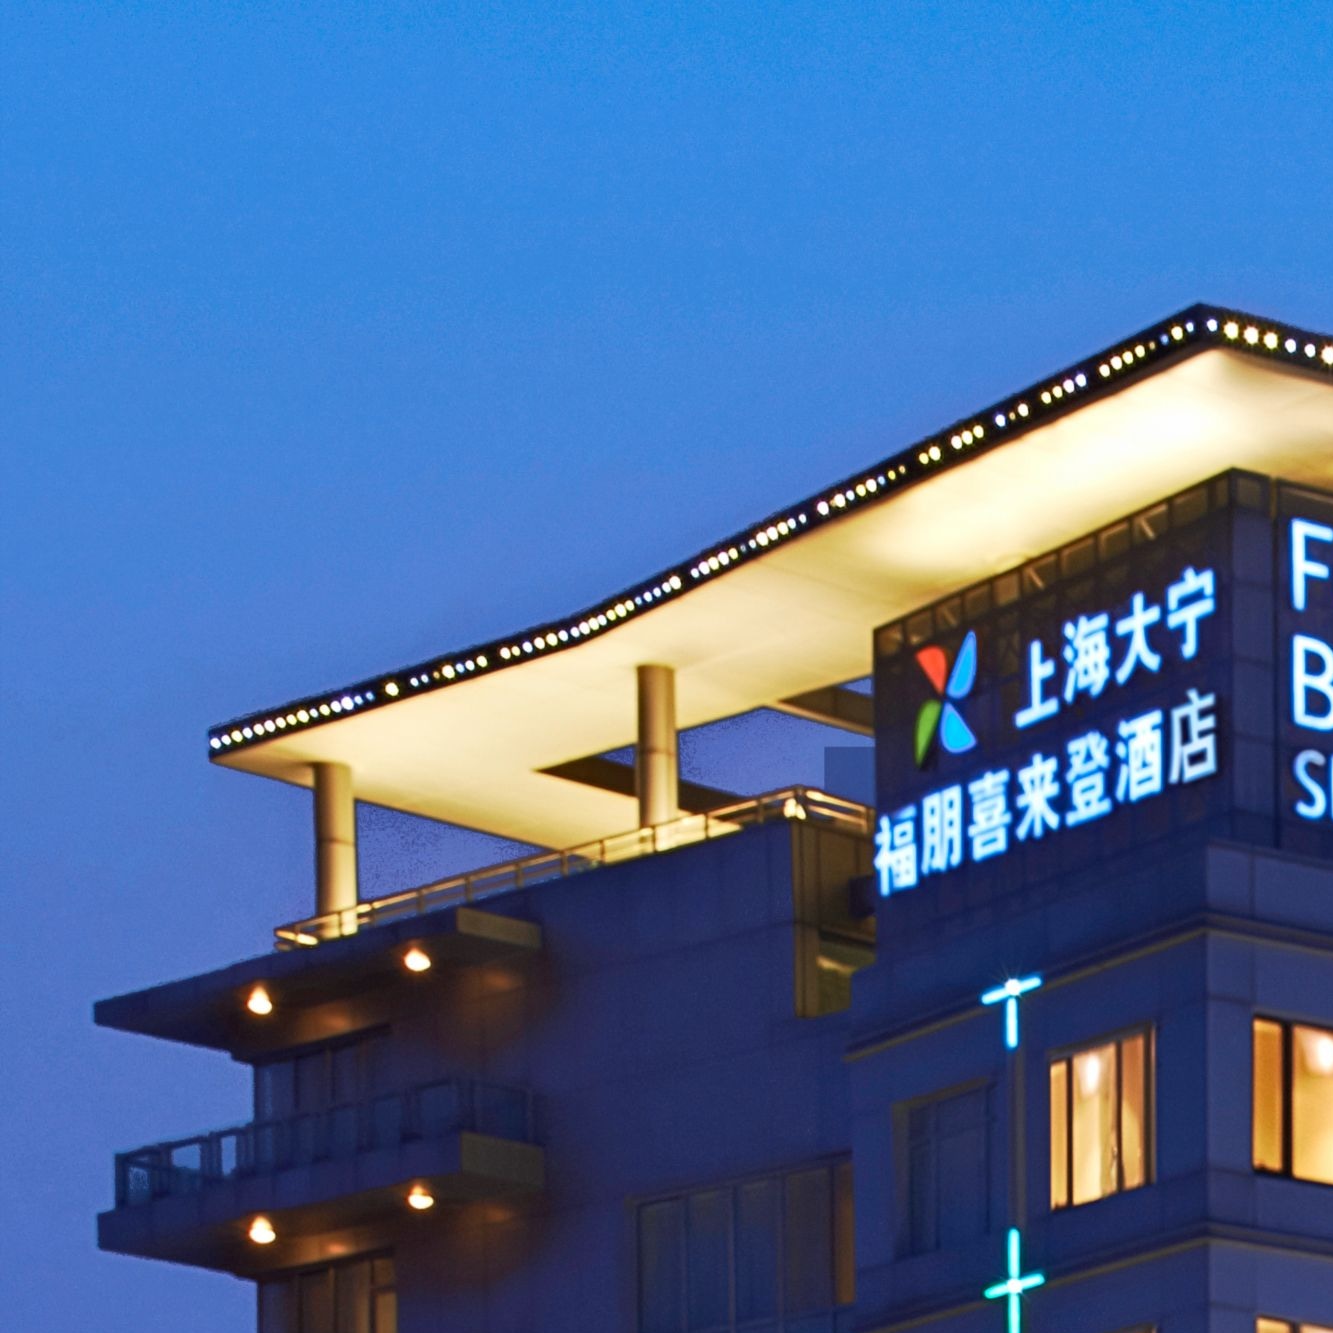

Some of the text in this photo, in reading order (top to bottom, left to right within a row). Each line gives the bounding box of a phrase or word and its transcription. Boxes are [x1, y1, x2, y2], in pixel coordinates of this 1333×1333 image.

[1013, 566, 1216, 729] 上海大宁
[873, 687, 1217, 897] 福朋喜来登酒店
